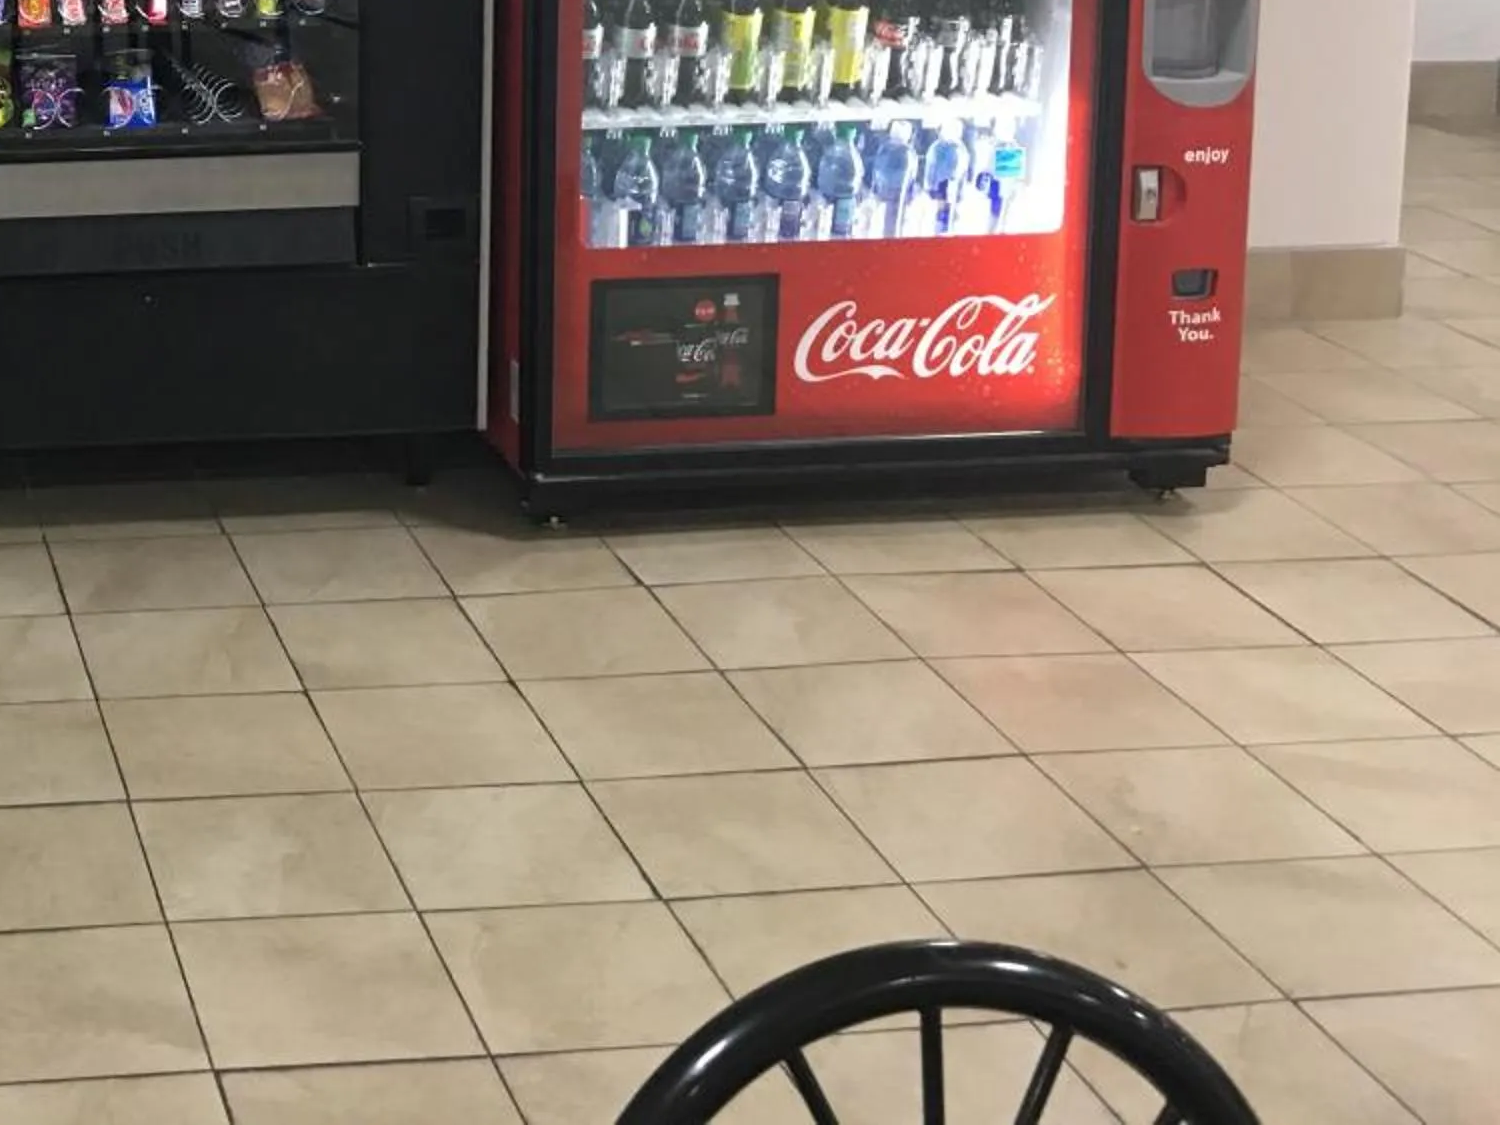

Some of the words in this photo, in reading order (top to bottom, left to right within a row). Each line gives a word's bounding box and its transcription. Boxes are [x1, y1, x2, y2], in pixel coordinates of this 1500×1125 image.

[1183, 147, 1230, 164] enjoy
[1168, 308, 1222, 324] Thank
[793, 293, 1057, 383] Coca-Cola
[1178, 327, 1215, 341] You.
